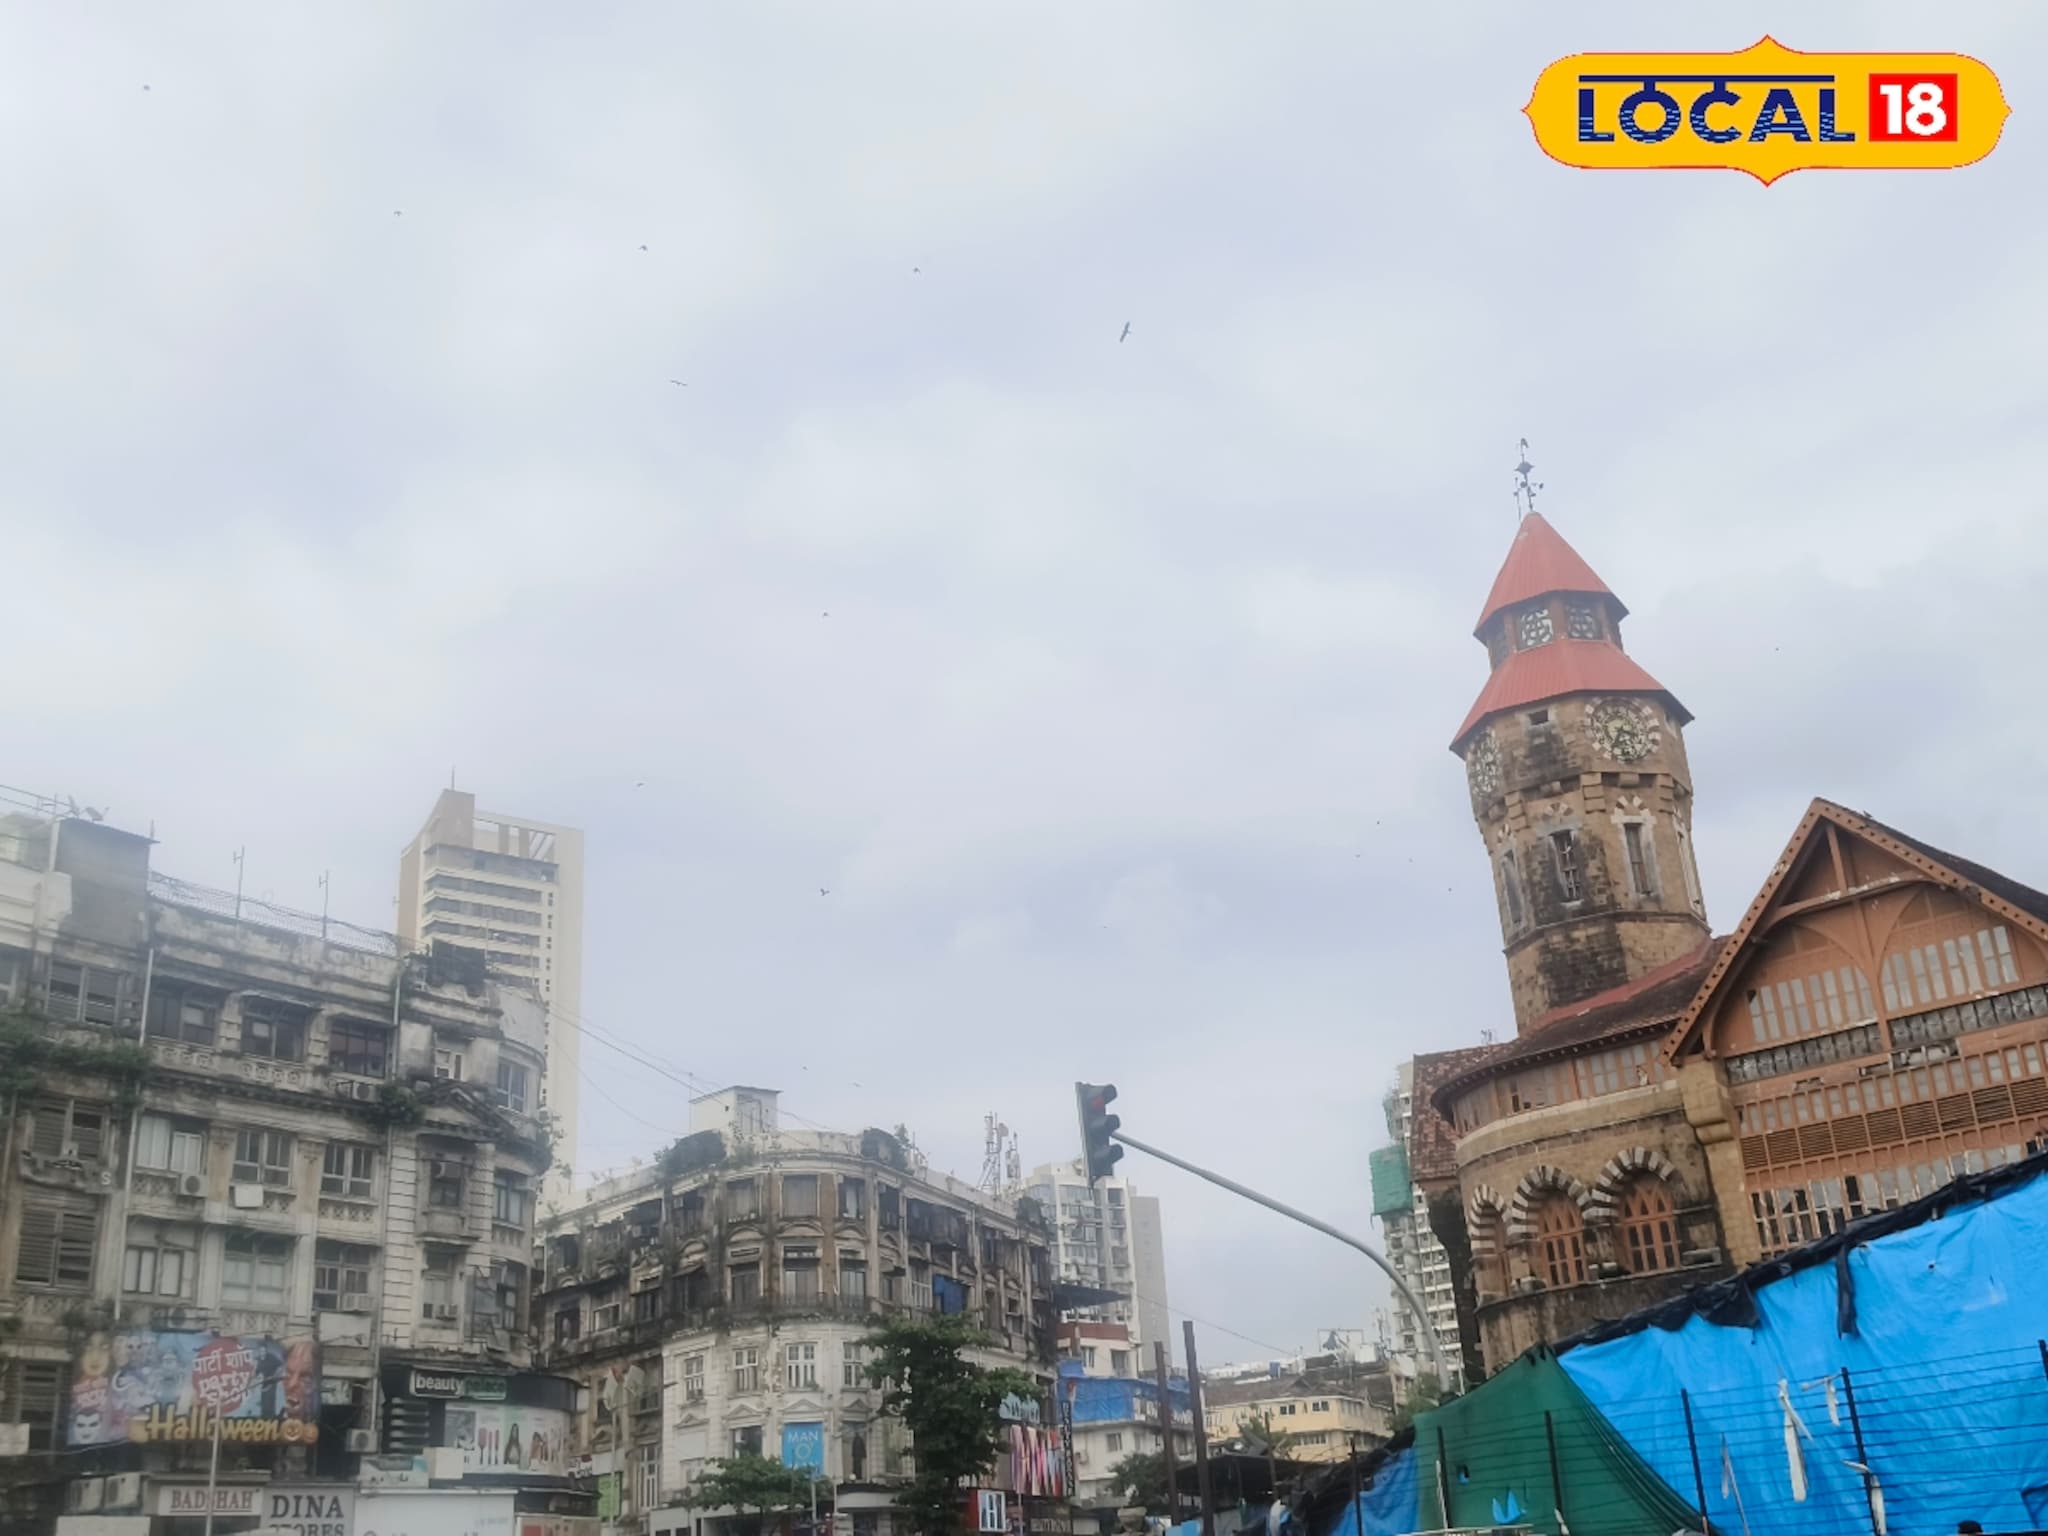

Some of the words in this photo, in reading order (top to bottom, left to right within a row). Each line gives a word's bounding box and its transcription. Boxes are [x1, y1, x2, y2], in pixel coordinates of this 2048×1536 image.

[192, 1346, 224, 1374] पार्टी
[224, 1344, 257, 1371] शॉप
[199, 1371, 251, 1398] party
[415, 1373, 464, 1396] beauty
[788, 1431, 819, 1443] MAN
[271, 1495, 345, 1518] DINA
